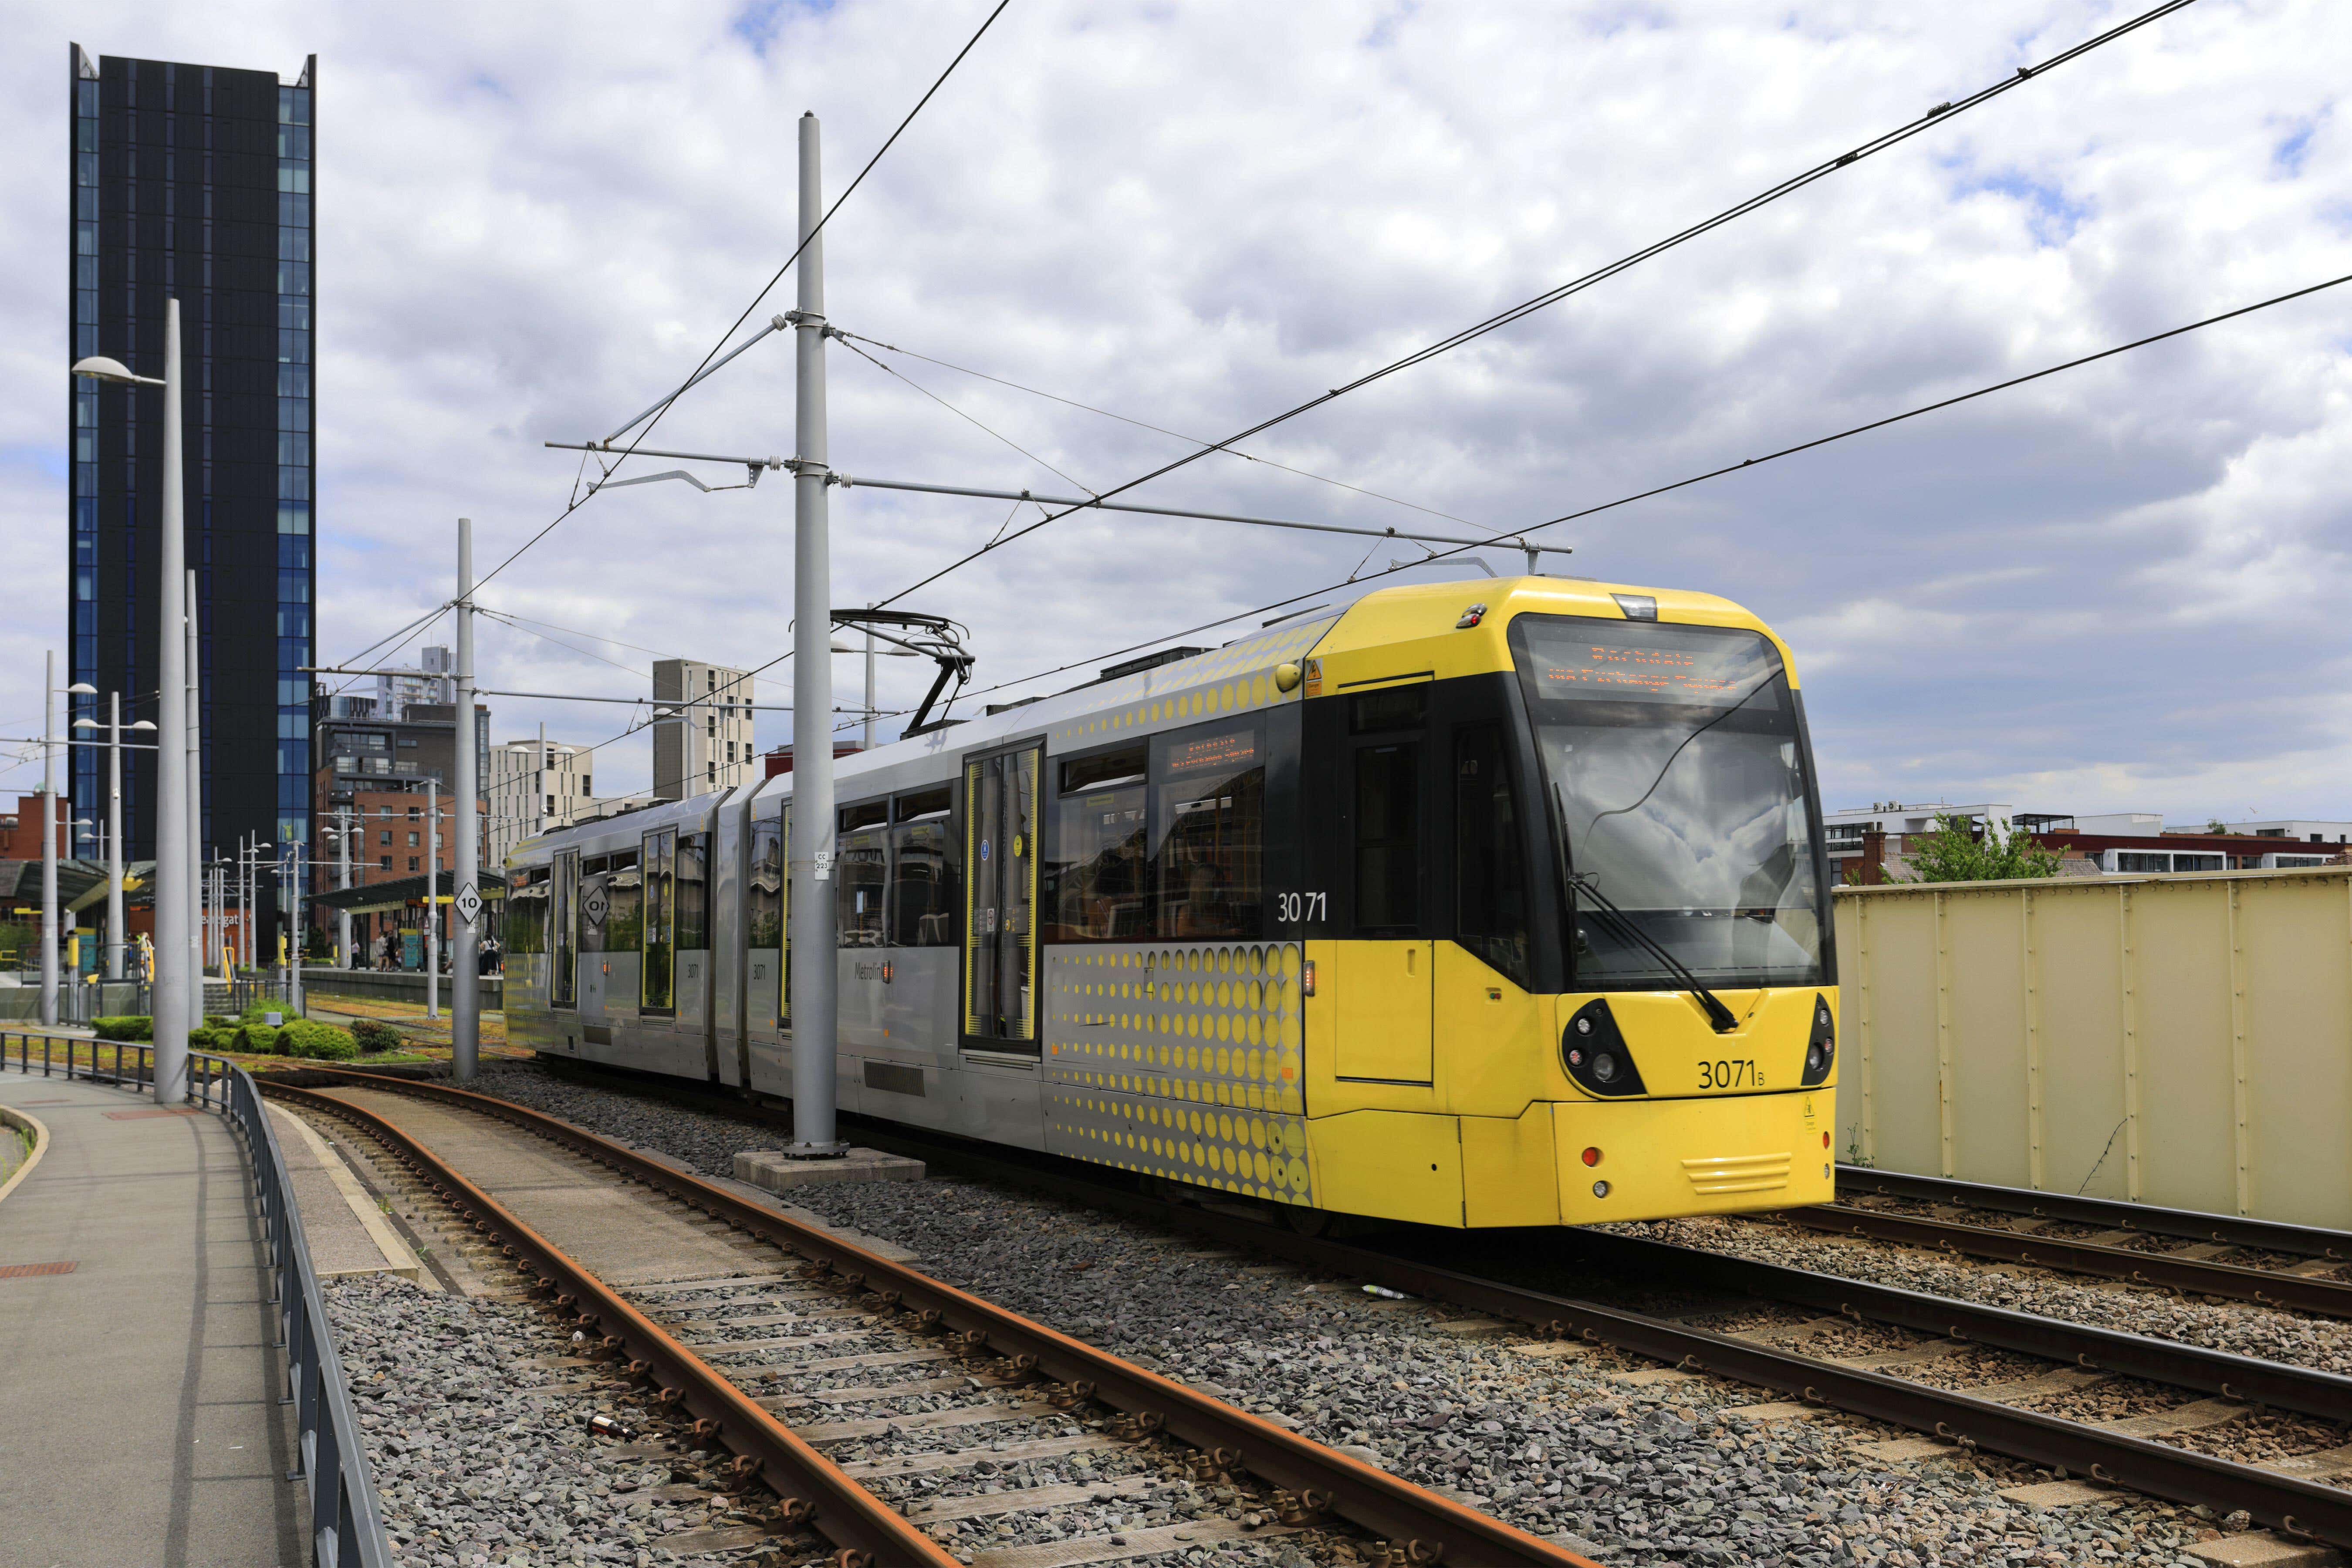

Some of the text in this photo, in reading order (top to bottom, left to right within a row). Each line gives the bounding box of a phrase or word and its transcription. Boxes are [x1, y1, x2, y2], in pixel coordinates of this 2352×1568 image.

[462, 898, 477, 908] 10
[1277, 892, 1326, 922] 3071
[688, 964, 698, 978] 3071
[754, 964, 766, 980] 3071
